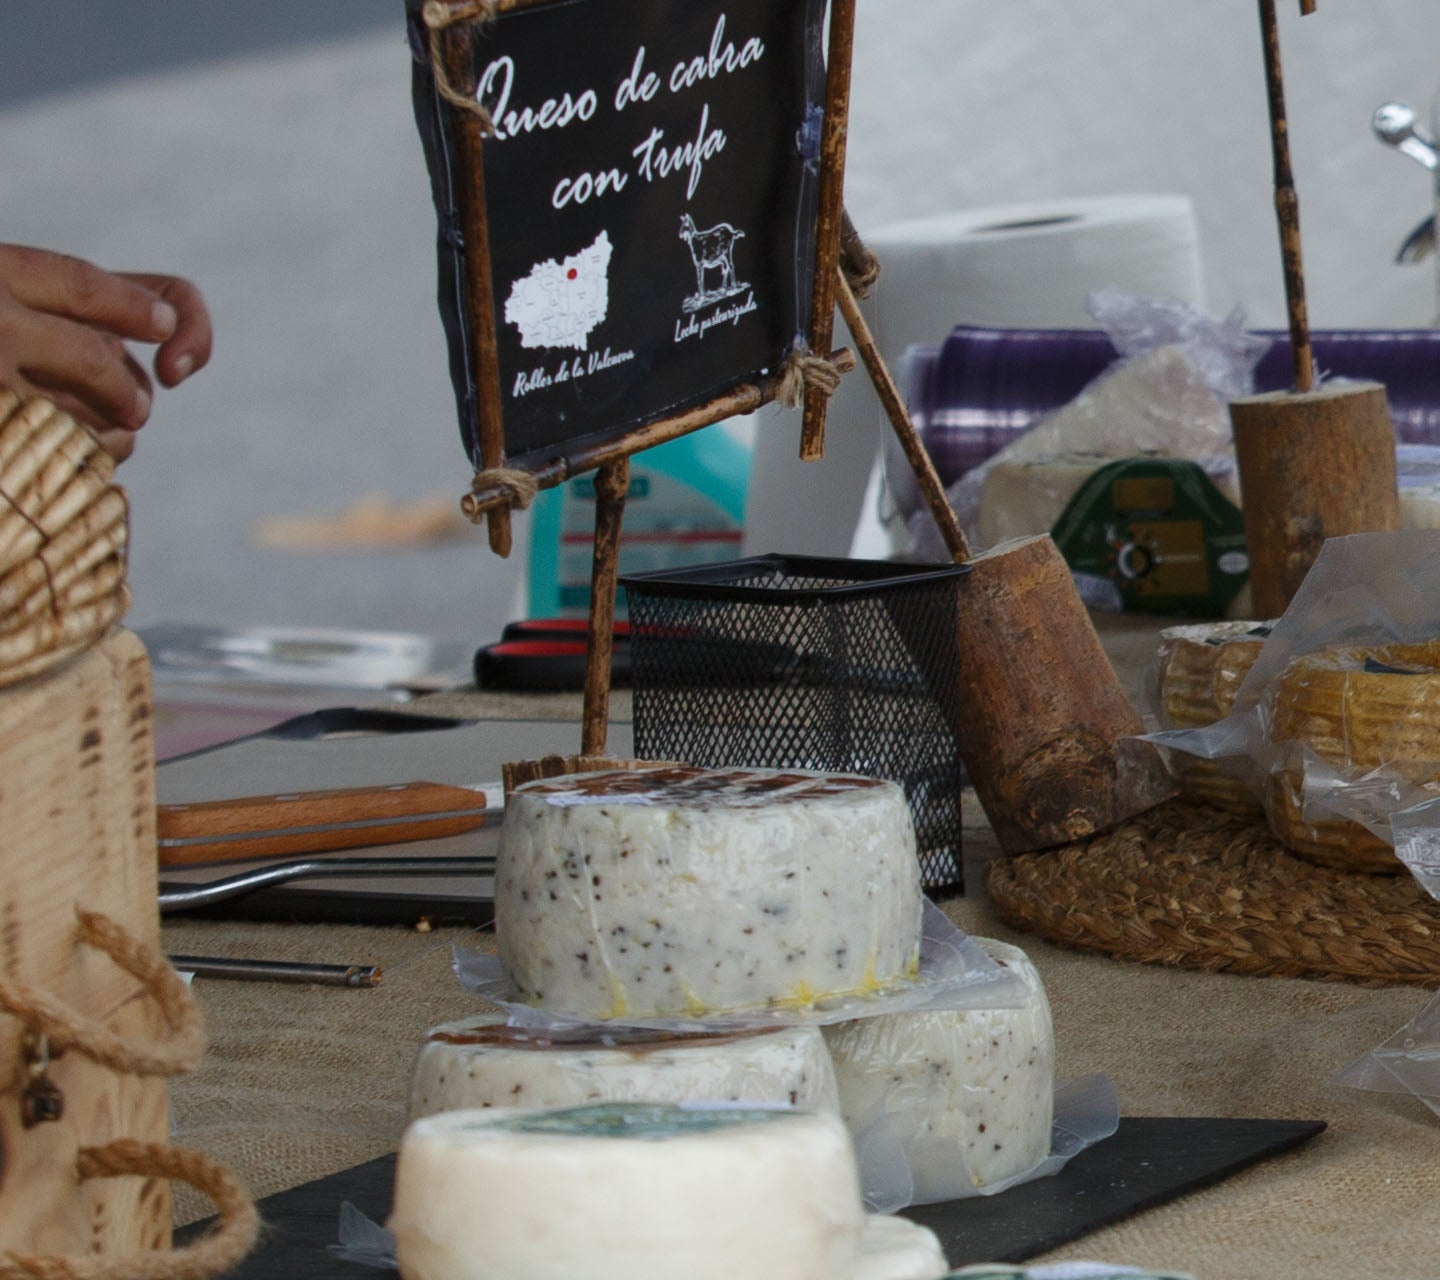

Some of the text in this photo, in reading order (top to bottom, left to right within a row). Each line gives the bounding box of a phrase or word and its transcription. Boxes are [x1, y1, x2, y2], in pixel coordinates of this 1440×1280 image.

[475, 12, 766, 142] Queso de cabra
[551, 101, 728, 210] con trufa
[554, 359, 570, 384] de
[571, 355, 585, 379] la
